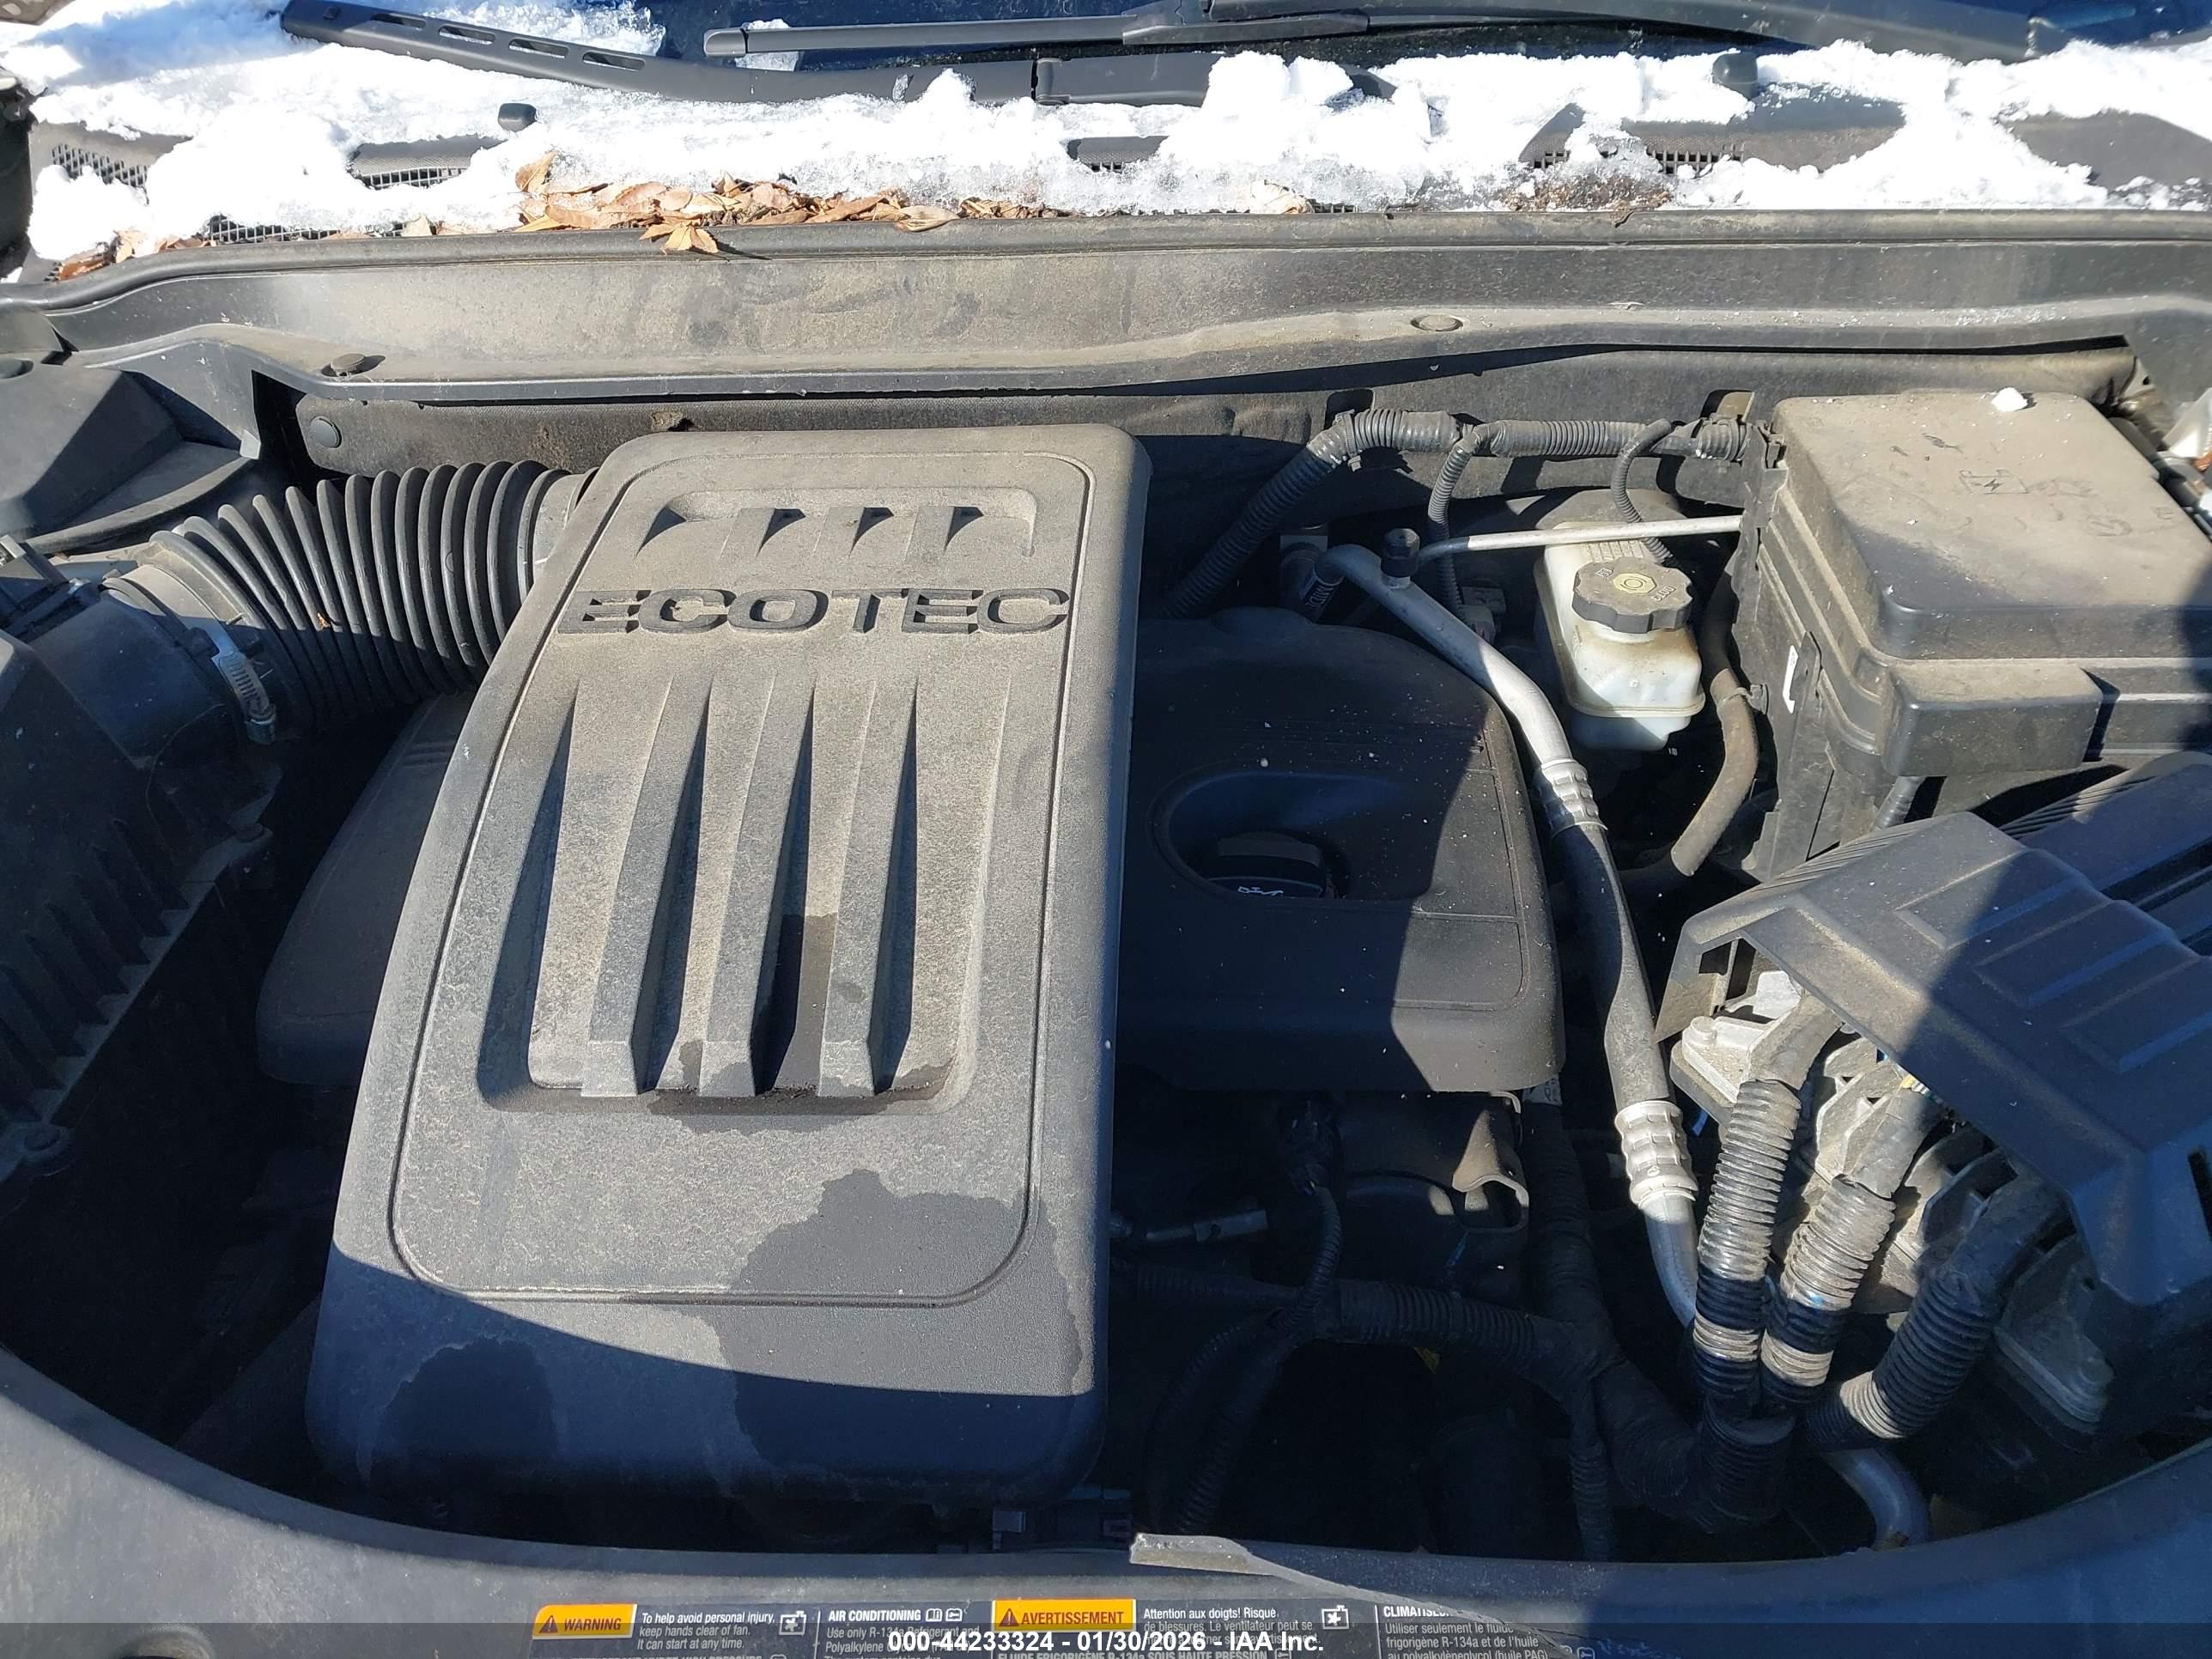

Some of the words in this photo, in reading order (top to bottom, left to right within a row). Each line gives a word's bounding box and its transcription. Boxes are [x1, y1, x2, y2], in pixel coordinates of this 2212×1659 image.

[556, 587, 1071, 635] ECOTEC
[641, 1613, 653, 1624] To
[655, 1612, 674, 1625] help
[677, 1611, 702, 1623] avoid
[705, 1612, 745, 1626] personal
[829, 1610, 846, 1622] AIR
[848, 1609, 921, 1622] CONDITIONING
[1021, 1611, 1125, 1625] AVERTISSEMENT
[1144, 1607, 1187, 1620] Attention
[1188, 1610, 1206, 1620] aux
[1209, 1607, 1241, 1621] doigts!
[1243, 1607, 1277, 1620] Risque
[563, 1618, 622, 1632] WARNING
[639, 1625, 663, 1638] keep
[665, 1625, 692, 1636] hands
[696, 1624, 720, 1636] clear
[721, 1624, 732, 1636] of
[732, 1624, 751, 1636] fan.
[1144, 1620, 1156, 1632] de
[1158, 1620, 1207, 1632] blessures.
[1209, 1620, 1222, 1632] Le
[1224, 1620, 1274, 1632] ventilateur
[1277, 1620, 1299, 1633] peut
[1301, 1622, 1313, 1631] se
[1384, 1622, 1419, 1634] Utiliser
[1421, 1622, 1473, 1634] seulement
[1475, 1621, 1485, 1633] le
[827, 1627, 845, 1638] Use
[847, 1627, 867, 1640] only
[637, 1638, 644, 1650] It
[646, 1639, 663, 1650] can
[665, 1638, 688, 1650] start
[690, 1638, 699, 1649] at
[701, 1638, 720, 1651] any
[721, 1637, 744, 1649] time.
[825, 1640, 884, 1654] Polyalkylene
[1386, 1636, 1440, 1650] frigorigène
[1441, 1637, 1480, 1649] R-134a
[1481, 1636, 1492, 1648] et
[1493, 1636, 1507, 1648] de
[1509, 1636, 1539, 1648] l'huile
